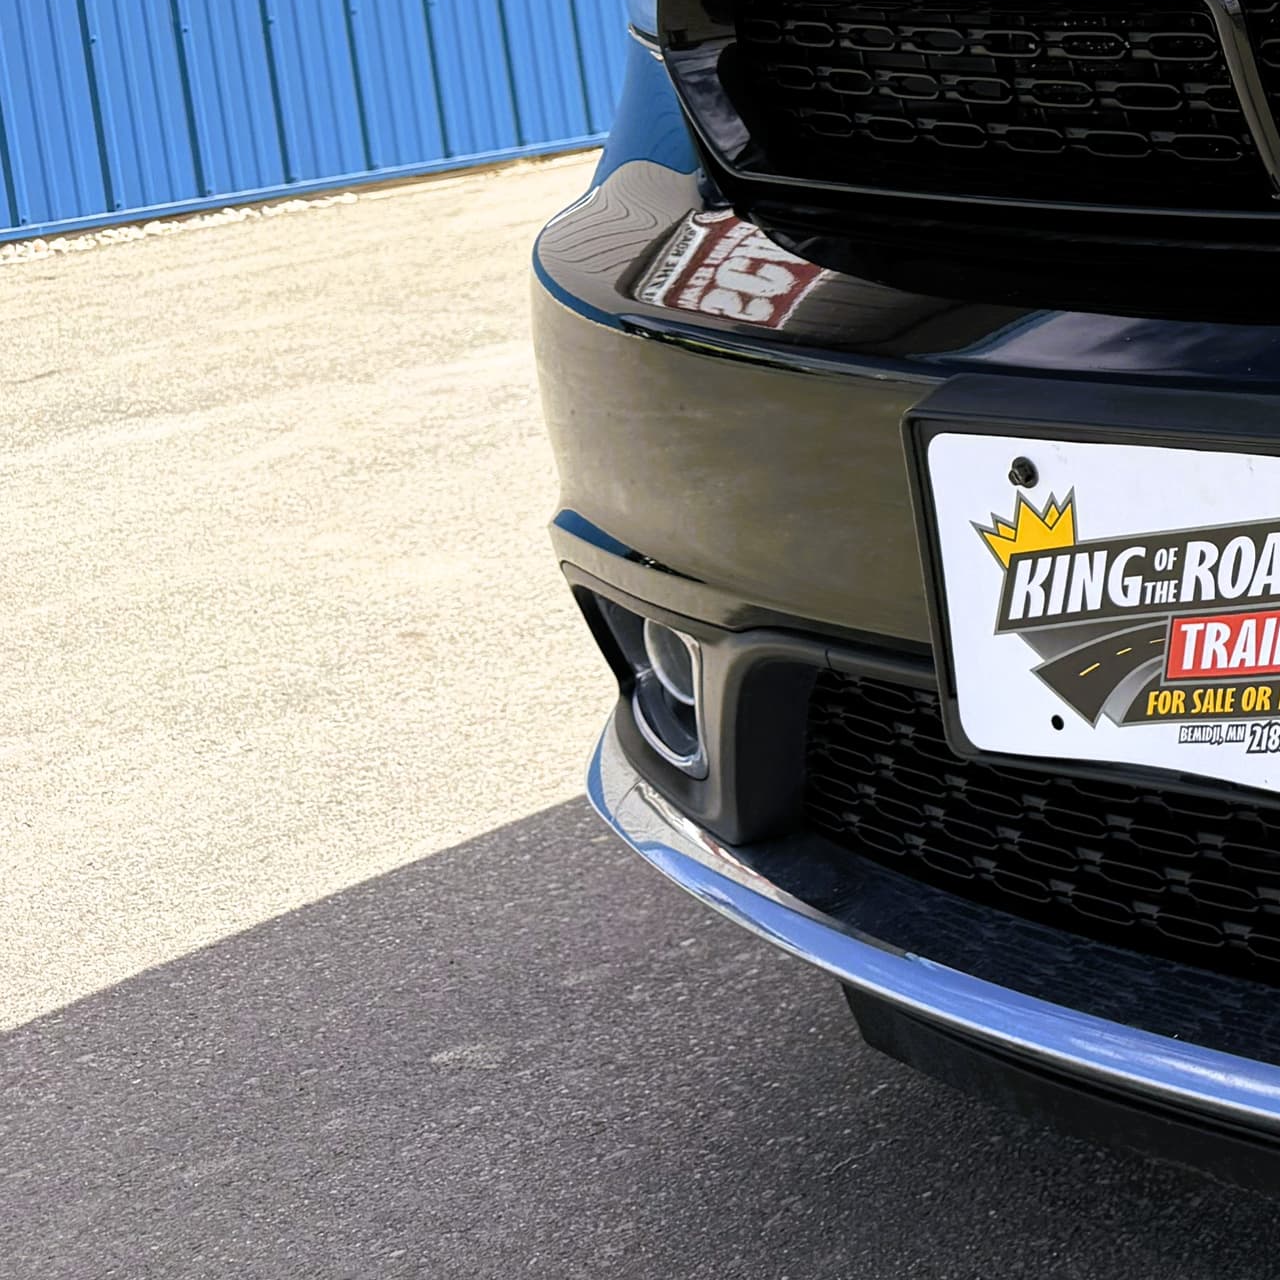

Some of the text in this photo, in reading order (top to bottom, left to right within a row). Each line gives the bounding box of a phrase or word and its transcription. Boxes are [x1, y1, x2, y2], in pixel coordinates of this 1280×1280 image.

[1154, 548, 1179, 572] OF
[1008, 546, 1147, 620] KING
[1145, 579, 1179, 606] THE
[1147, 690, 1186, 716] FOR
[1190, 687, 1236, 714] SALE
[1241, 685, 1273, 712] OR
[1178, 725, 1224, 745] BEMIDJI,
[1225, 724, 1247, 743] MN
